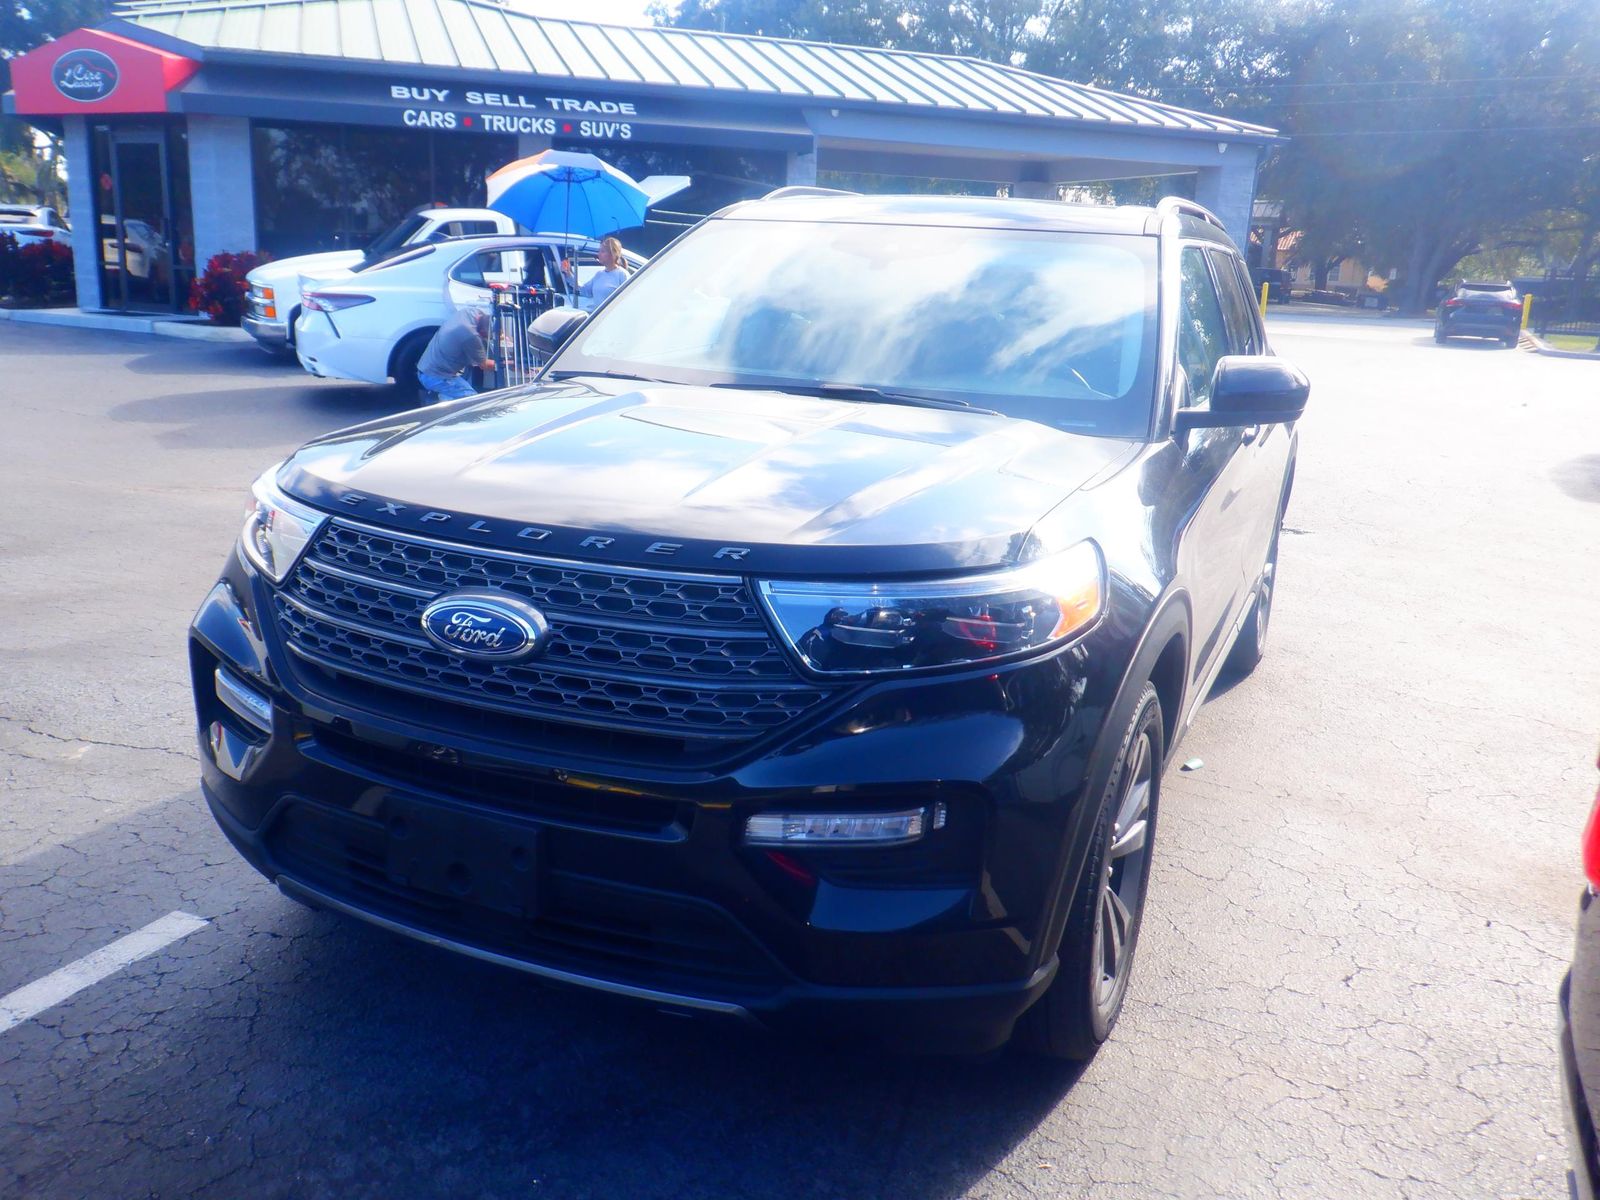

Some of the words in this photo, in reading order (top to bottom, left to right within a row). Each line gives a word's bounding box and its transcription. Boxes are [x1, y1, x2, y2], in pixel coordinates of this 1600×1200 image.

[390, 85, 450, 101] BUY
[465, 91, 536, 108] SELL
[545, 97, 637, 115] TRADE
[402, 109, 457, 128] CARS
[481, 114, 556, 134] TRUCKS
[579, 121, 632, 139] SUV'S
[339, 493, 751, 561] EXPLORER
[444, 611, 505, 648] Ford
